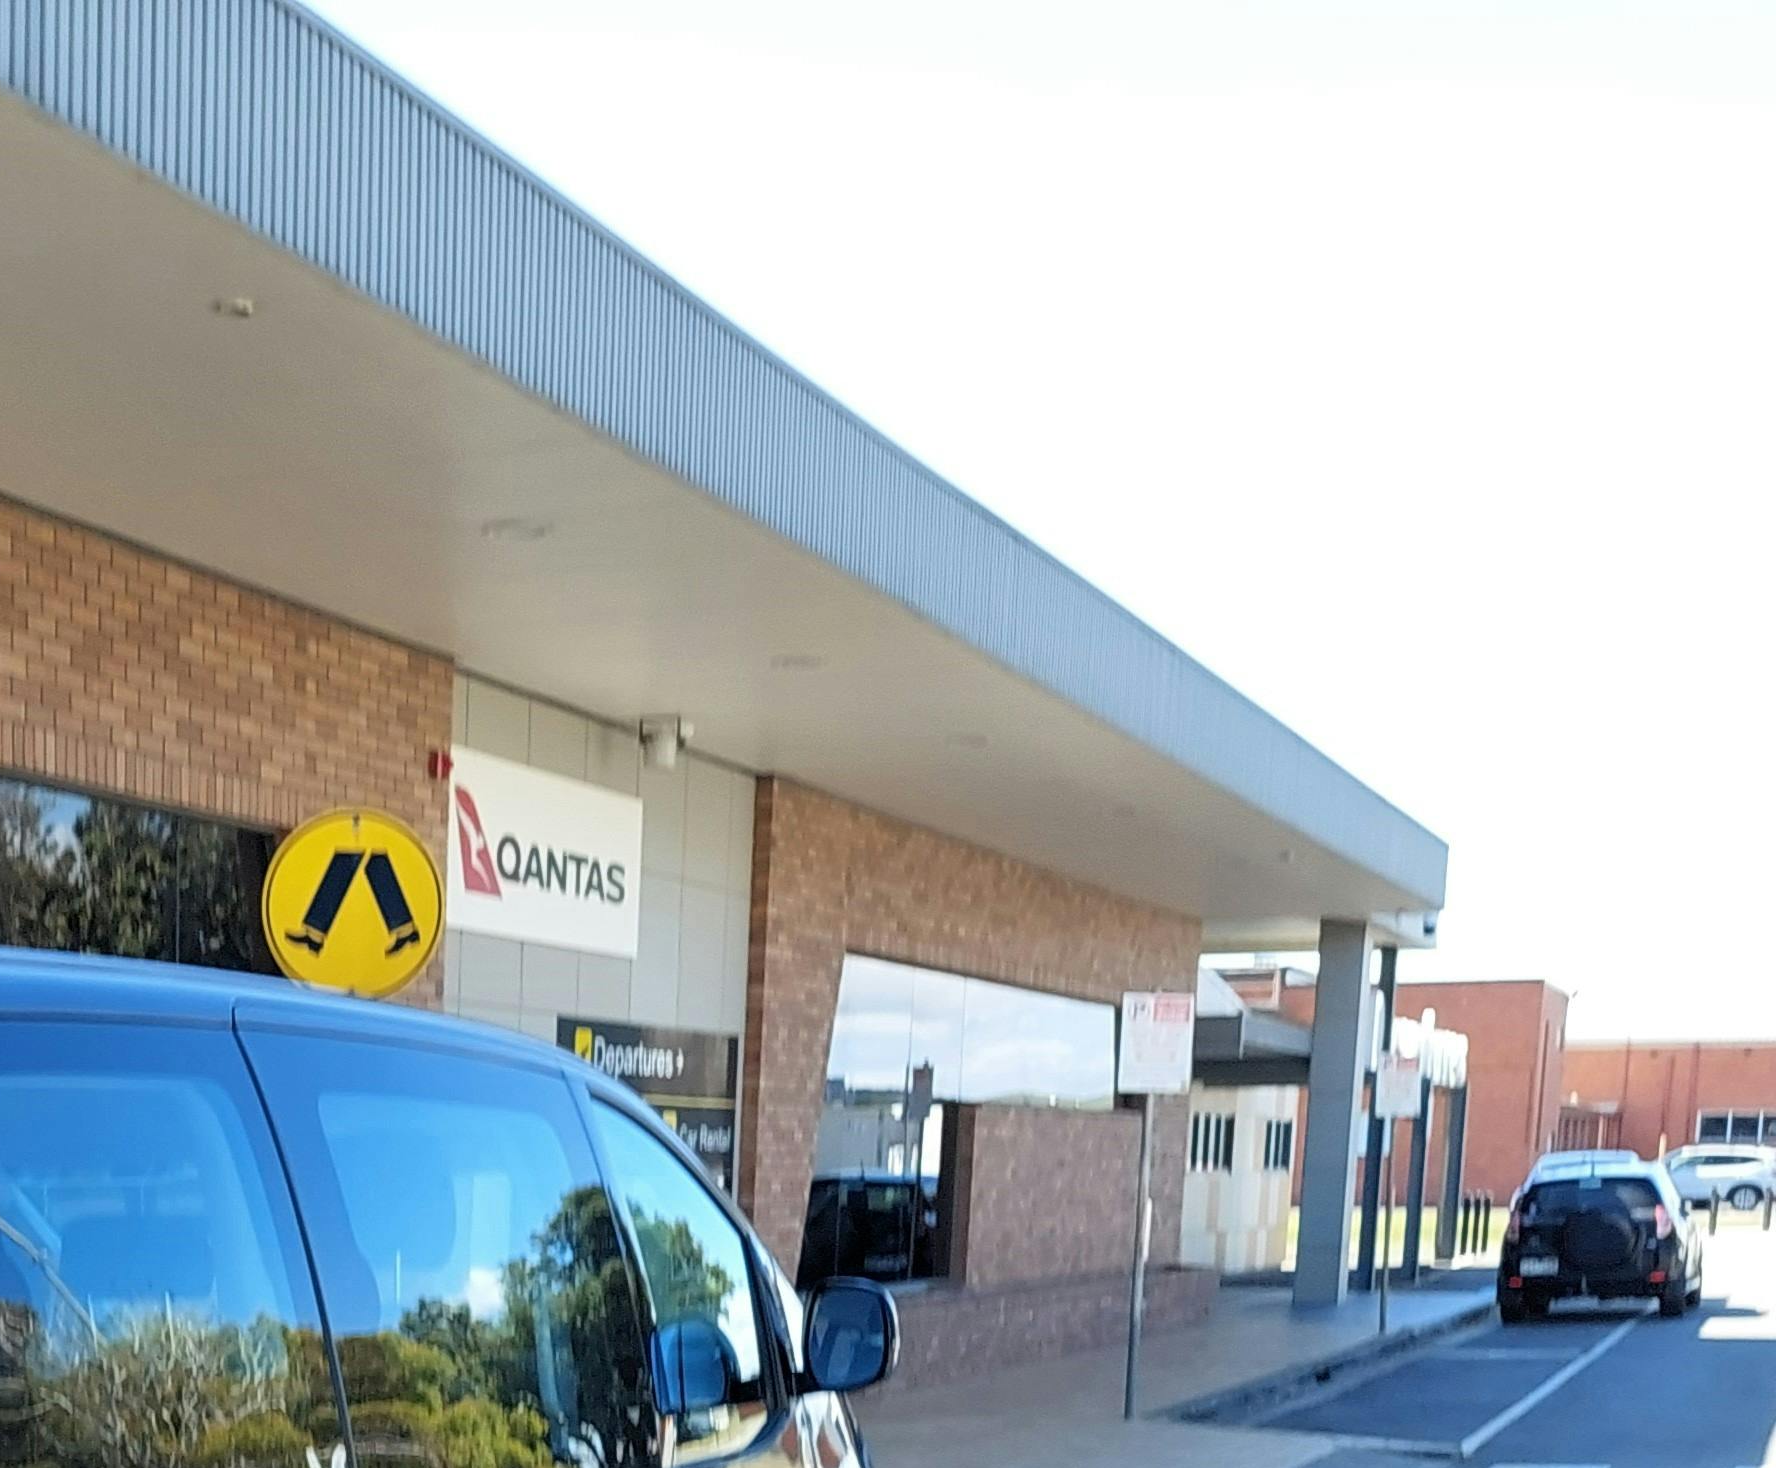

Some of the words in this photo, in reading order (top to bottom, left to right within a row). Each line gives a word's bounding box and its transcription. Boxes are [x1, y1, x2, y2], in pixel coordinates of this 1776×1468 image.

[495, 835, 626, 905] QANTAS
[593, 1034, 674, 1081] Departures
[699, 1122, 732, 1153] Rental
